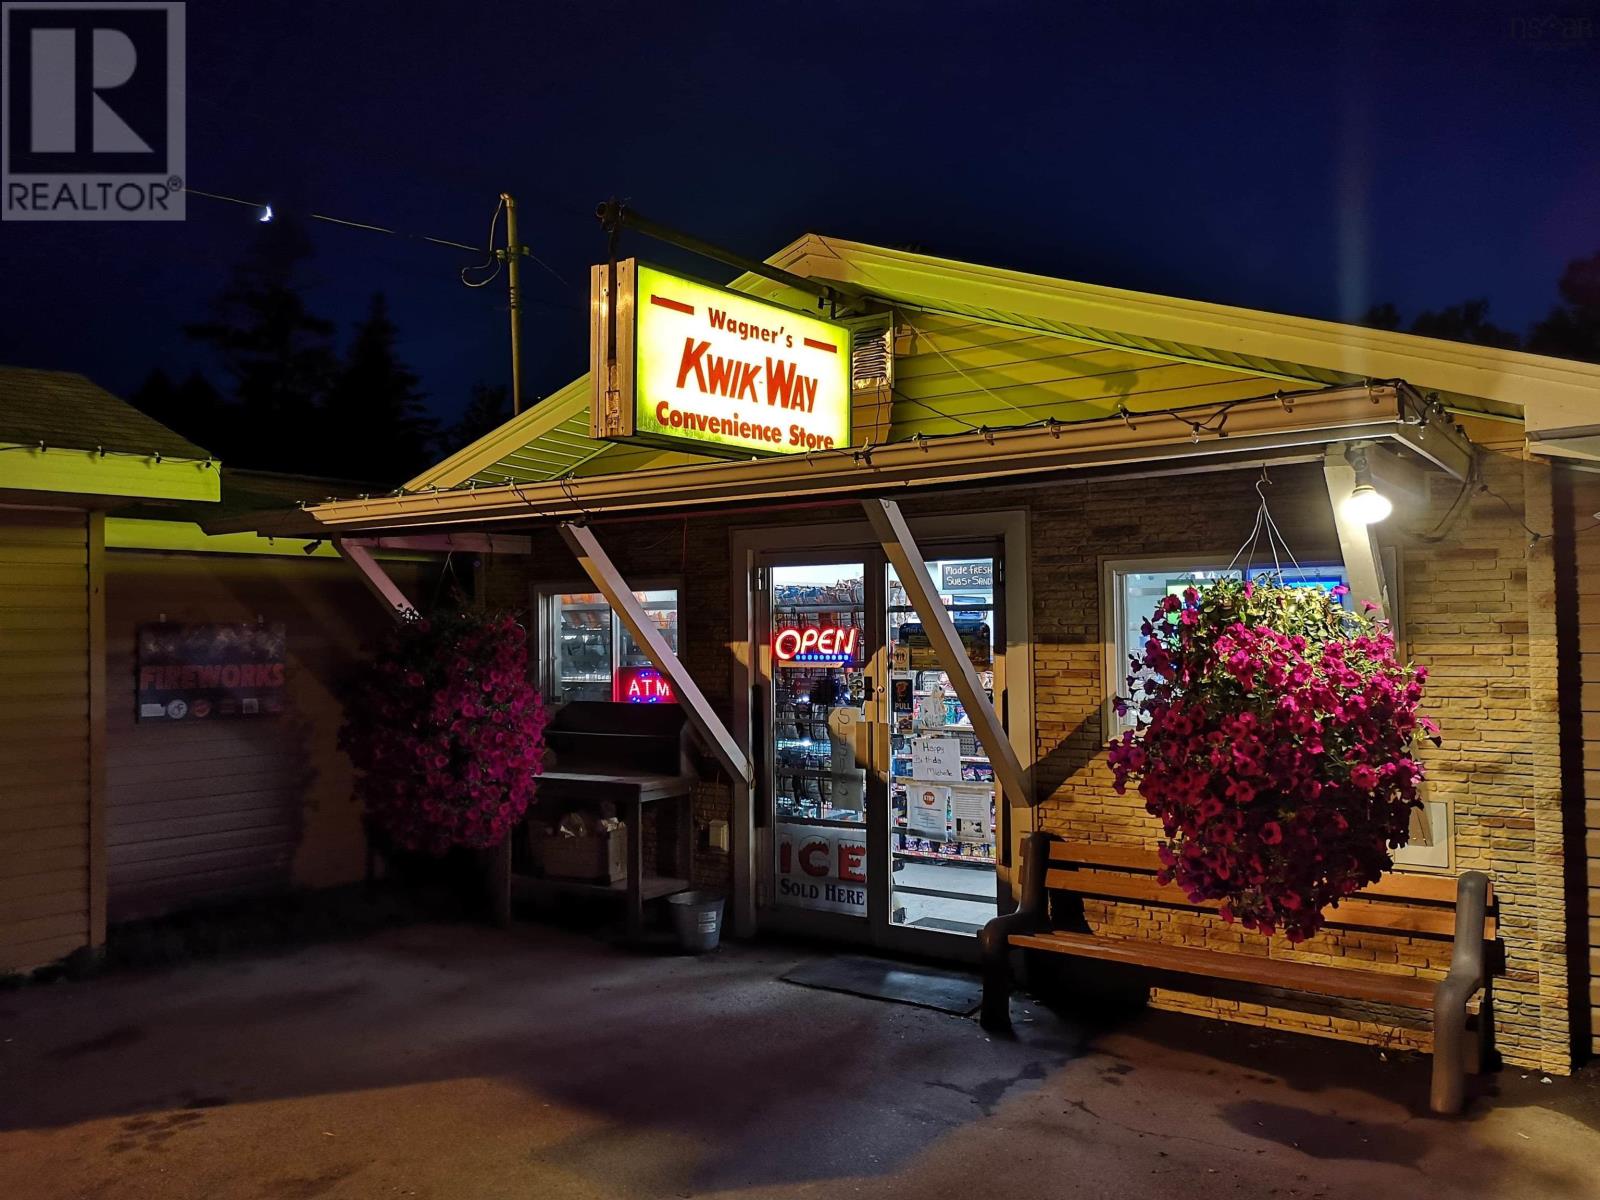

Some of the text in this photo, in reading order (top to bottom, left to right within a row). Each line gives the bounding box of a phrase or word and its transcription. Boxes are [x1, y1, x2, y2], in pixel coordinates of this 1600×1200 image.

[708, 307, 794, 349] Wagner's
[656, 400, 835, 450] Convenience Store
[775, 628, 857, 660] OPEN
[139, 663, 286, 690] FIREWORKS
[628, 679, 670, 697] ATM
[895, 702, 912, 711] PULL
[779, 833, 868, 884] ICE
[780, 878, 865, 906] SOLD HERE
